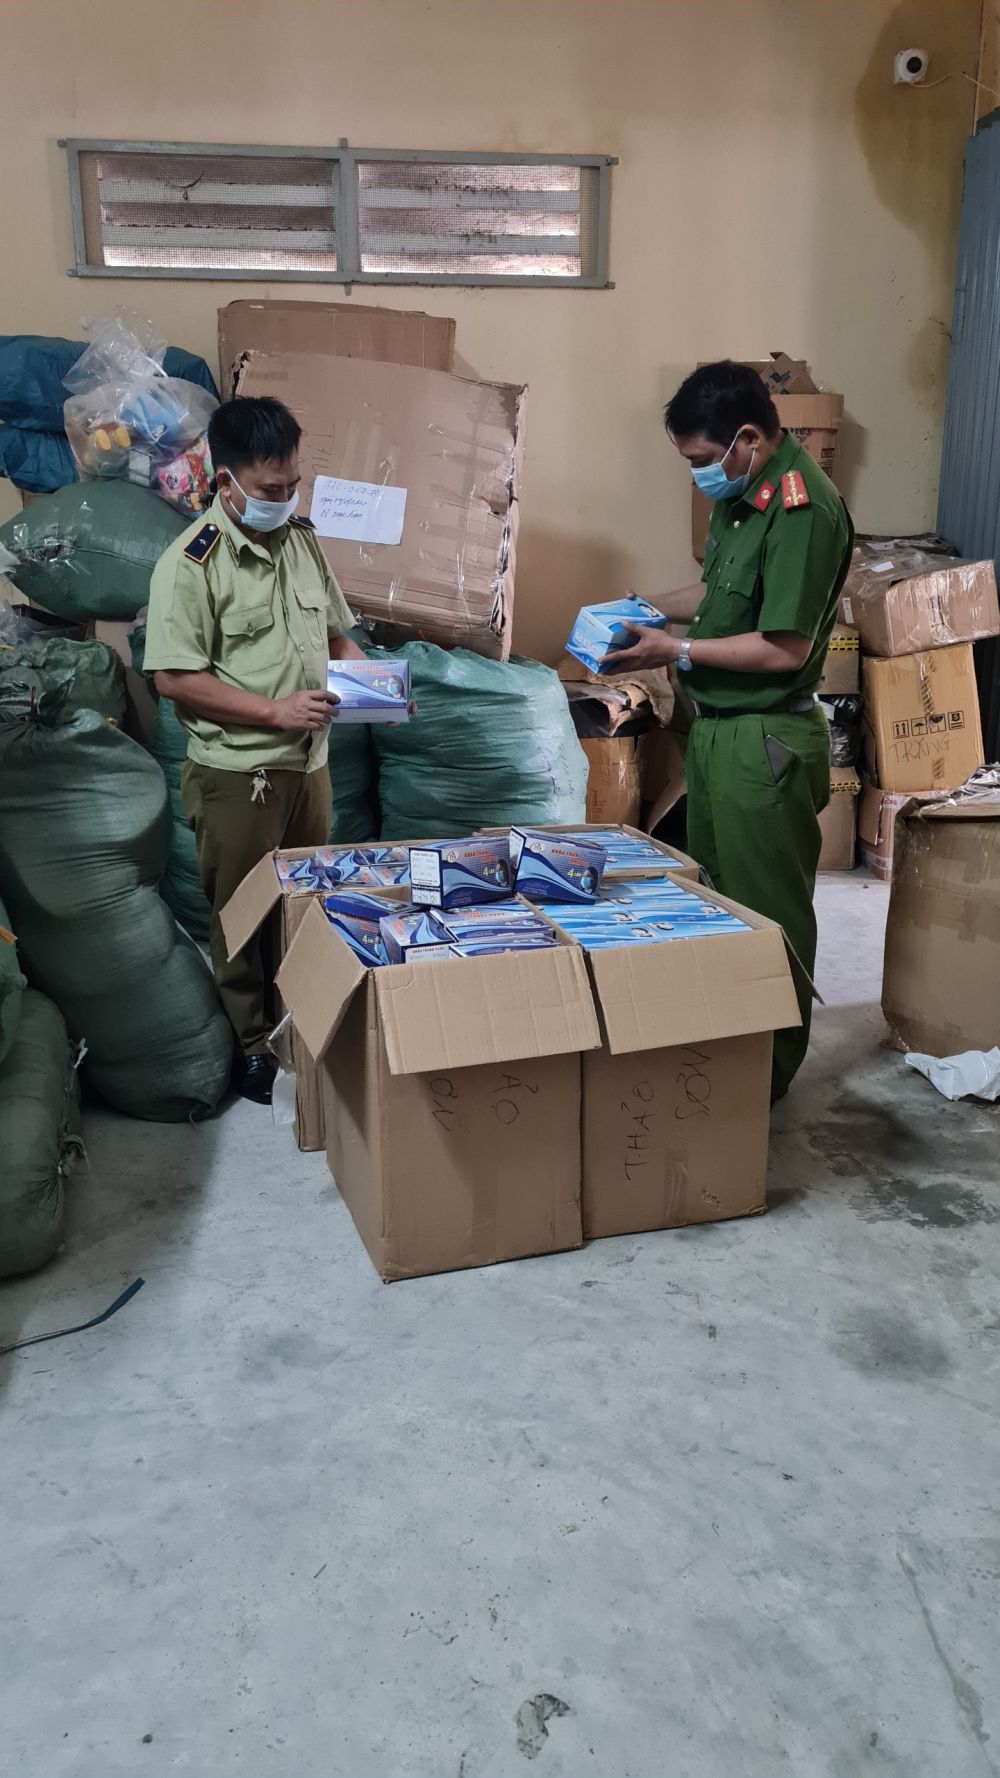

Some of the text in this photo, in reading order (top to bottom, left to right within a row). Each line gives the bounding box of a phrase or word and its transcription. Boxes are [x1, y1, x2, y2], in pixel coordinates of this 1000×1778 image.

[483, 865, 489, 876] 4
[567, 868, 574, 878] 4
[362, 934, 368, 944] 4
